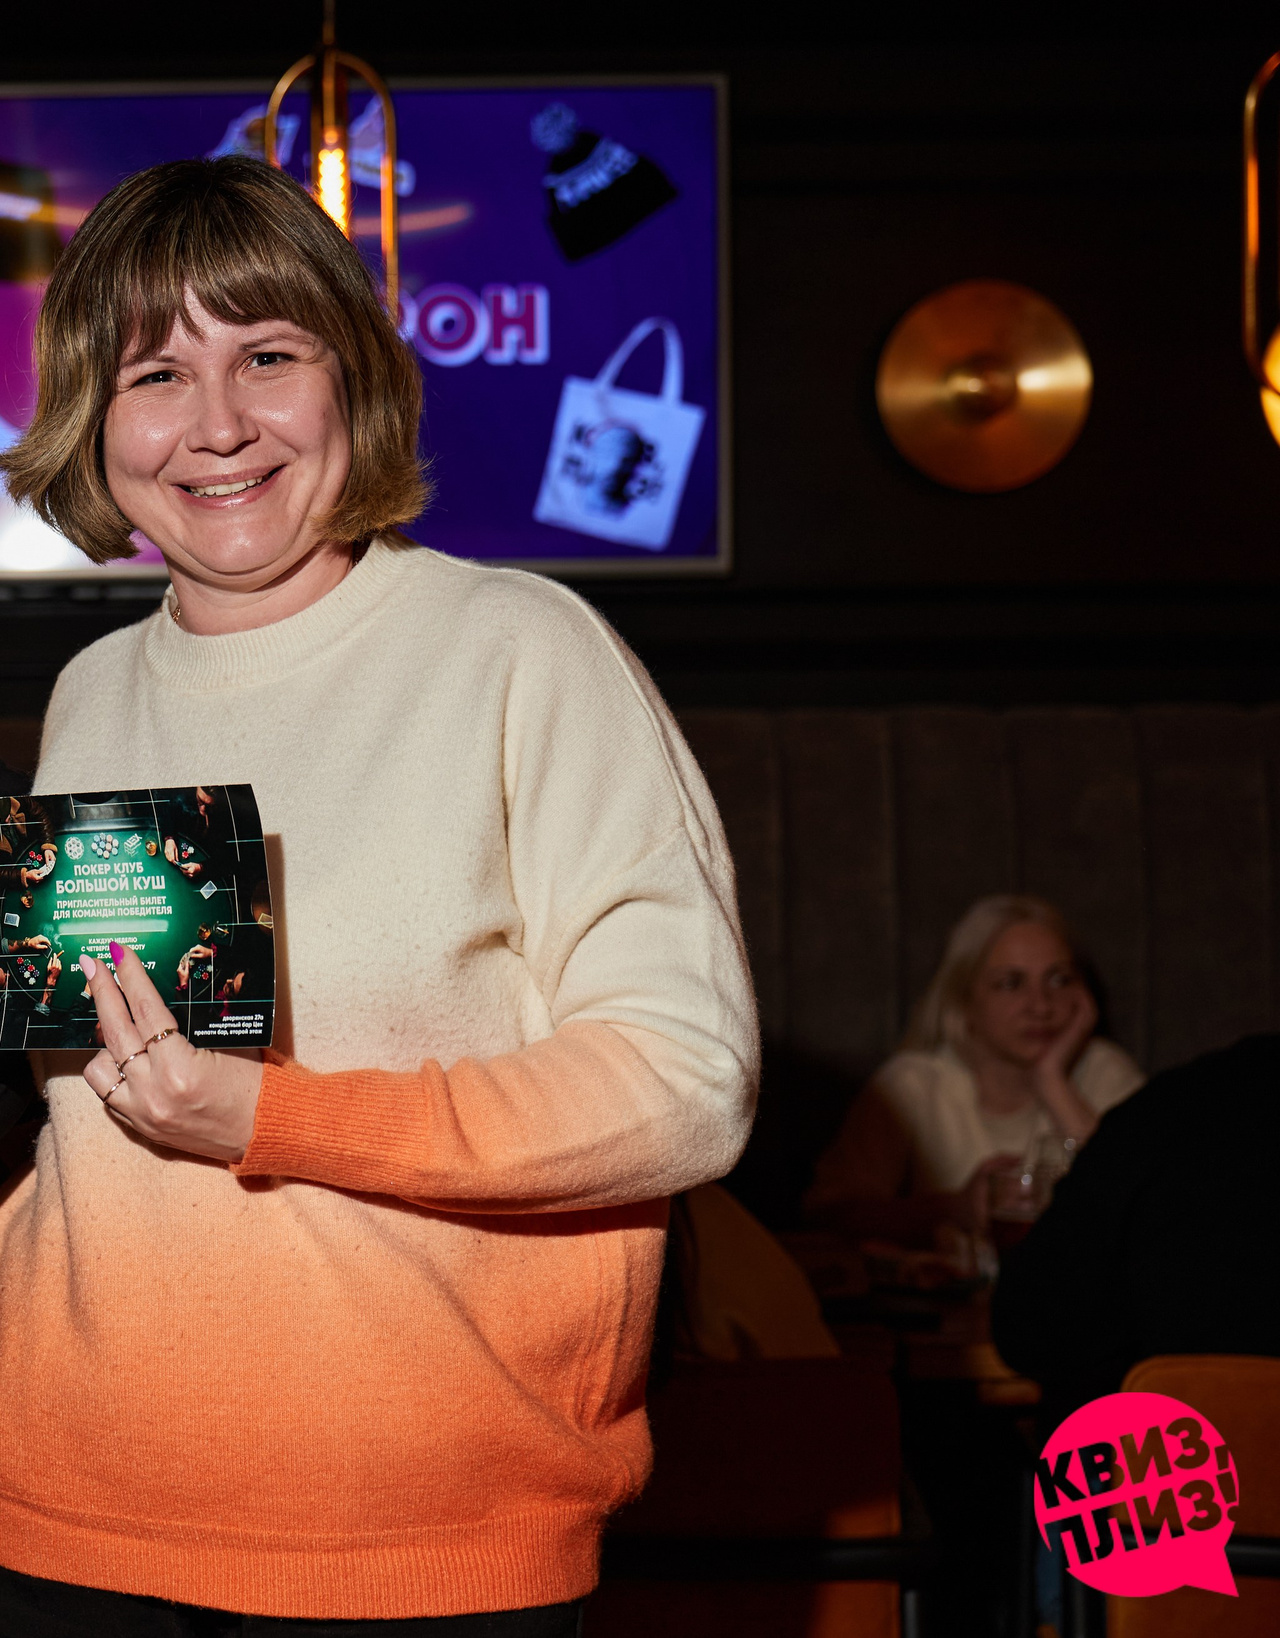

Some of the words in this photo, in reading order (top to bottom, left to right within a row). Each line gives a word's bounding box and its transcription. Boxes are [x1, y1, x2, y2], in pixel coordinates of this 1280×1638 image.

[74, 863, 111, 876] ПОКЕР
[114, 862, 144, 875] КЛУБ
[55, 874, 130, 894] БОЛЬШОЙ
[132, 875, 166, 891] КУШ
[56, 895, 139, 909] ПРИГЛАСИТЕЛЬНЫЙ
[139, 896, 167, 906] БИЛЕТ
[52, 910, 71, 921] ДЛЯ
[72, 908, 116, 919] КОМАНДЫ
[117, 906, 173, 917] ПОБЕДИТЕЛЯ
